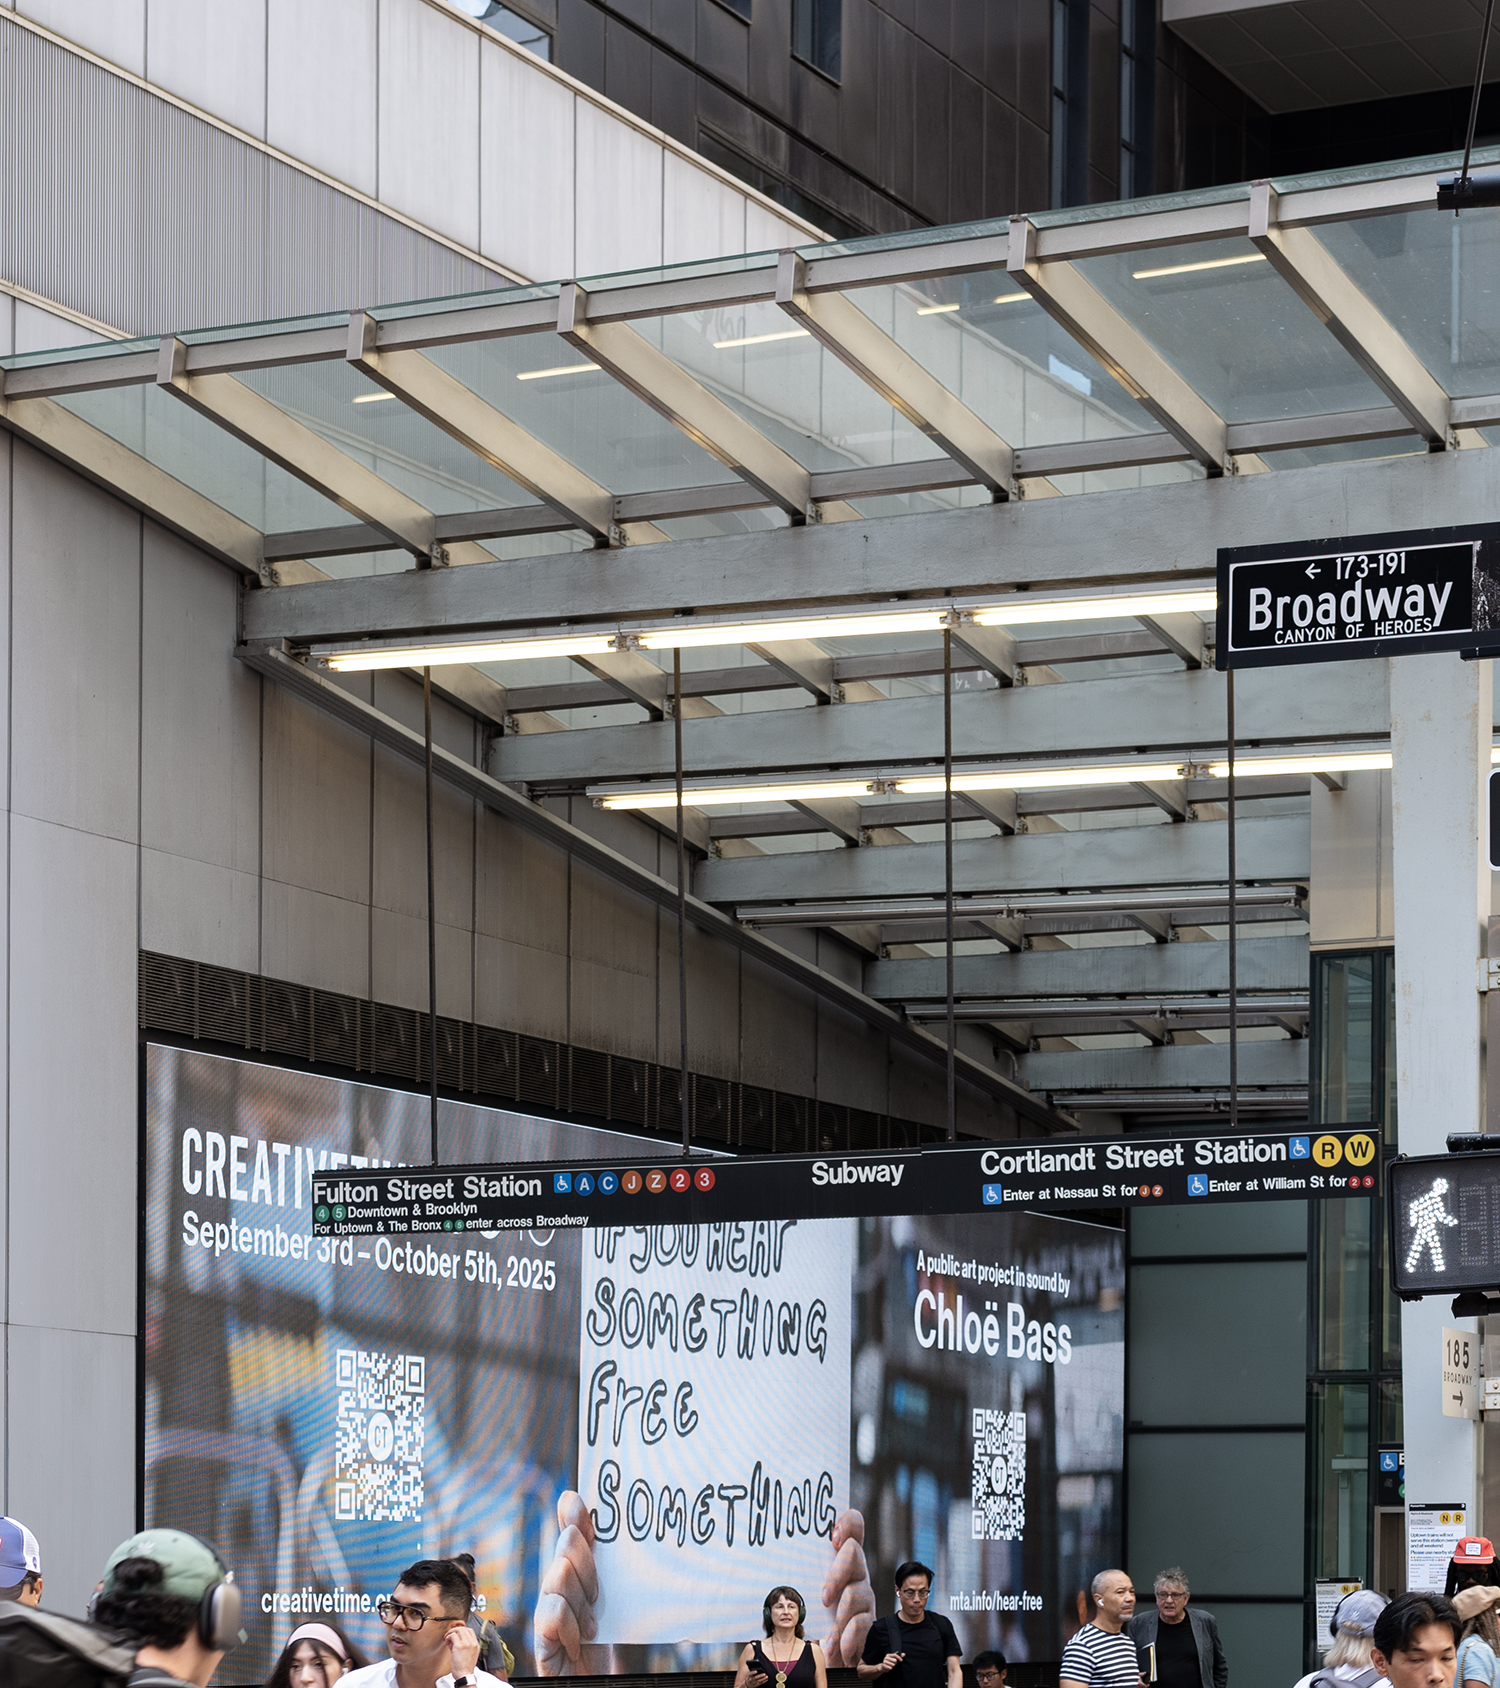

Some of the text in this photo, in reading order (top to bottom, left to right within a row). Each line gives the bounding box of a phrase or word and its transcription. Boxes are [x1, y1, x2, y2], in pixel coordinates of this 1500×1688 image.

[1335, 551, 1407, 580] 173-191
[1249, 578, 1453, 631] Broadway
[1274, 617, 1433, 645] CANYON OF HEROES
[182, 1127, 414, 1209] CREATI
[980, 1148, 1096, 1175] Cortlandt
[1106, 1143, 1185, 1170] Street
[1194, 1139, 1287, 1165] Station
[811, 1161, 905, 1186] Subway
[1209, 1179, 1241, 1193] Enter
[1246, 1179, 1259, 1191] at
[1263, 1177, 1306, 1190] William
[1310, 1176, 1325, 1188] St
[1329, 1175, 1347, 1187] for
[314, 1181, 378, 1204] Fulton
[386, 1178, 454, 1201] Street
[463, 1175, 542, 1198] Station
[1003, 1188, 1034, 1202] Enter
[1038, 1189, 1050, 1200] at
[1054, 1187, 1098, 1199] Nassau
[1102, 1185, 1116, 1197] St
[1120, 1184, 1138, 1197] for
[348, 1205, 408, 1219] Downtown
[412, 1204, 422, 1217] &
[425, 1202, 478, 1217] Brooklyn
[314, 1223, 331, 1235] For
[334, 1222, 373, 1236] Uptown
[376, 1221, 385, 1232] &
[388, 1220, 408, 1232] The
[411, 1219, 442, 1231] Bronx
[465, 1217, 493, 1229] enter
[496, 1217, 533, 1228] across
[536, 1215, 589, 1229] Broadway
[182, 1210, 556, 1292] September 3rd October 5th, 2025
[917, 1250, 1071, 1298] A public art project in sound by
[914, 1288, 1072, 1365] Chloë Bass
[1447, 1338, 1470, 1369] 185
[1443, 1371, 1473, 1386] BROADWAY
[950, 1590, 1043, 1612] mta.info/hear-free
